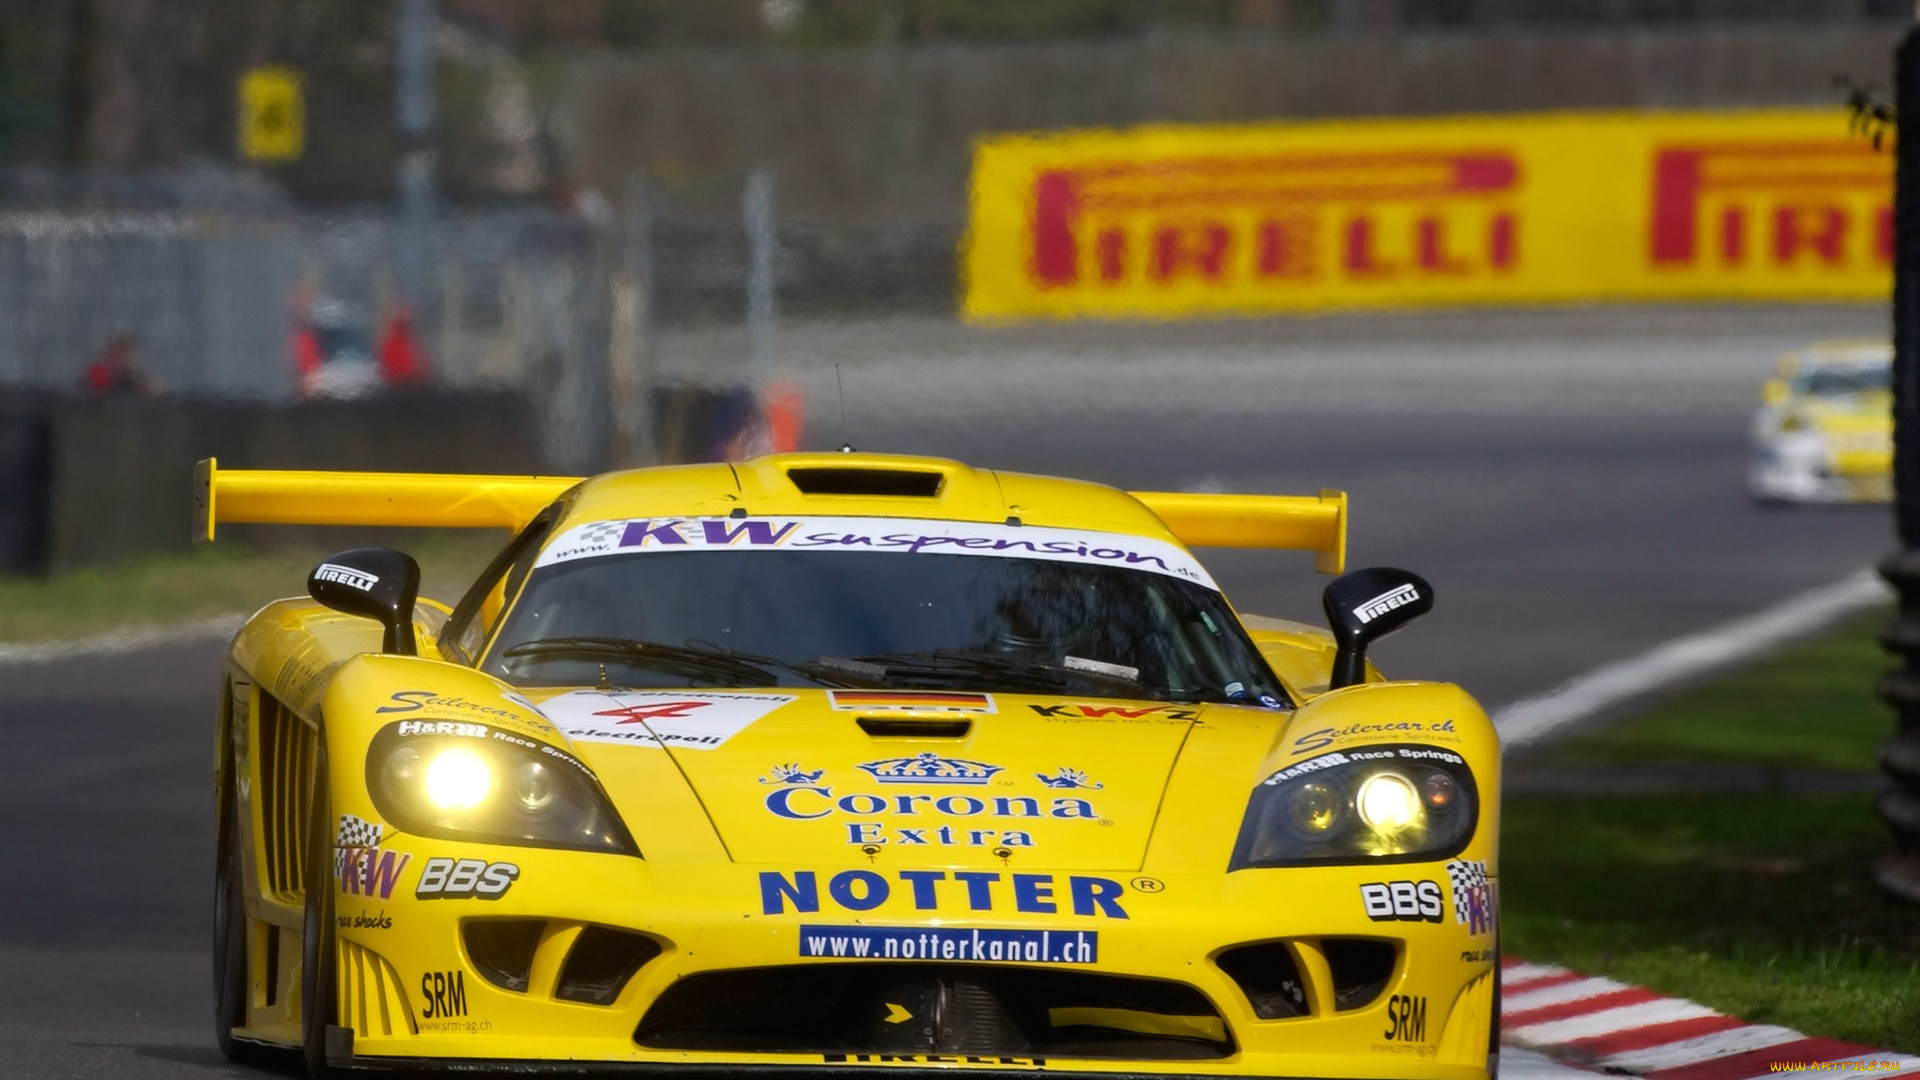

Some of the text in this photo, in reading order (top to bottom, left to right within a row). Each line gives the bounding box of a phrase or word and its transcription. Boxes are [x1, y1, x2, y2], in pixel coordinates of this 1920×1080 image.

[1033, 152, 1521, 288] PIRELLI
[1649, 143, 1895, 266] PIR
[619, 521, 802, 548] KW
[315, 563, 379, 592] PIRELLI
[1352, 583, 1420, 624] PIRELLI
[592, 701, 714, 725] 4
[493, 731, 537, 749] Race
[1291, 719, 1456, 756] Seilercar.ch
[1350, 749, 1395, 762] Race
[1399, 747, 1463, 765] Springs
[765, 786, 1100, 820] Corona
[846, 822, 1036, 848] Extra
[341, 845, 413, 899] KW
[415, 857, 520, 900] BBS
[758, 870, 1131, 920] NOTTER
[1360, 880, 1444, 924] BBS
[354, 909, 392, 929] shocks
[808, 929, 1092, 963] www.notterkanal.ch
[422, 971, 468, 1018] SRM
[1384, 994, 1427, 1042] SRM
